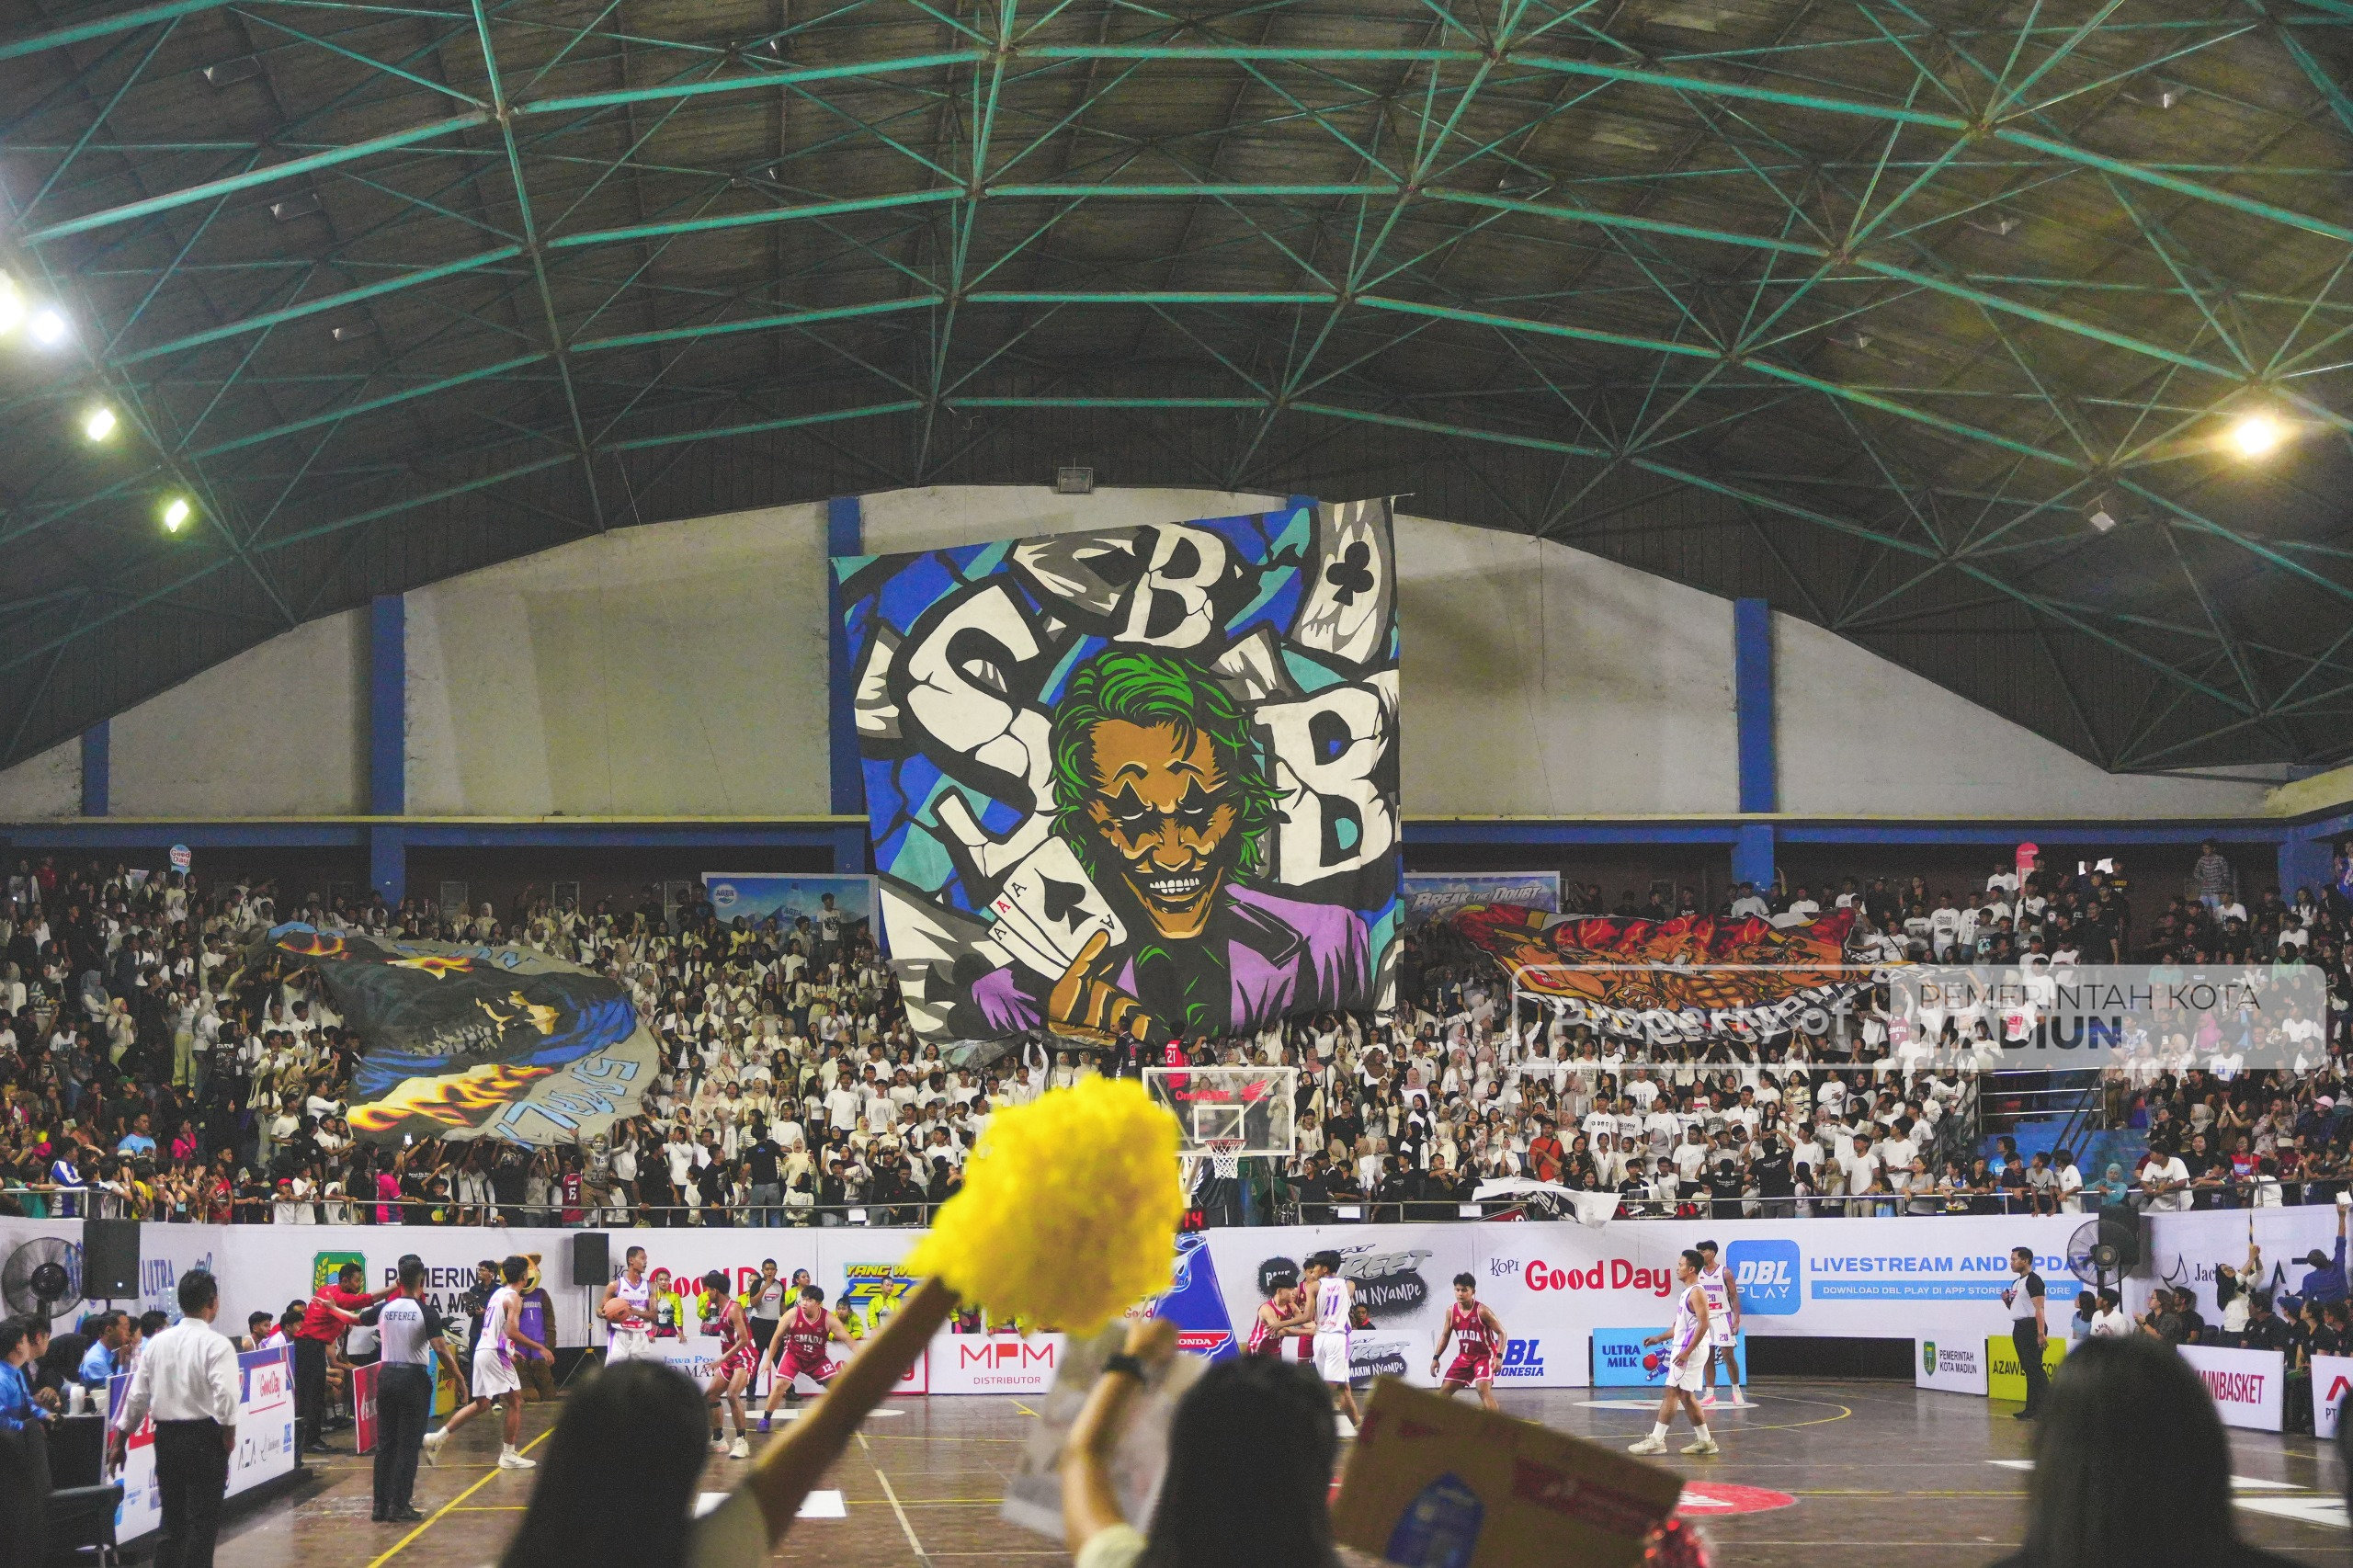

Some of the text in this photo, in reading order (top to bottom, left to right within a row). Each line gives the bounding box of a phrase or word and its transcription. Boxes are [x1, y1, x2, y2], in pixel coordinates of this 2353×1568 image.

[1184, 1211, 1202, 1228] 14
[1811, 1256, 1952, 1272] LIVESTREAM
[1960, 1256, 2007, 1271] AND
[847, 1265, 892, 1278] YANG
[1525, 1260, 1604, 1290] Good
[1611, 1259, 1671, 1297] Day
[1735, 1261, 1791, 1284] DBL
[1735, 1287, 1790, 1299] PLAY
[384, 1311, 417, 1322] REFEREE
[961, 1343, 1053, 1369] MPM
[1502, 1339, 1544, 1366] BL
[1602, 1345, 1641, 1356] ULTRA
[1939, 1349, 1974, 1362] PEMERINTAH
[823, 1364, 834, 1372] 12
[1607, 1357, 1637, 1368] MILK
[1939, 1361, 1977, 1374] KOTA MADIUN
[1477, 1366, 1483, 1375] 7
[973, 1376, 1040, 1385] DISTRIBUTOR
[2196, 1369, 2265, 1404] AINBASKET
